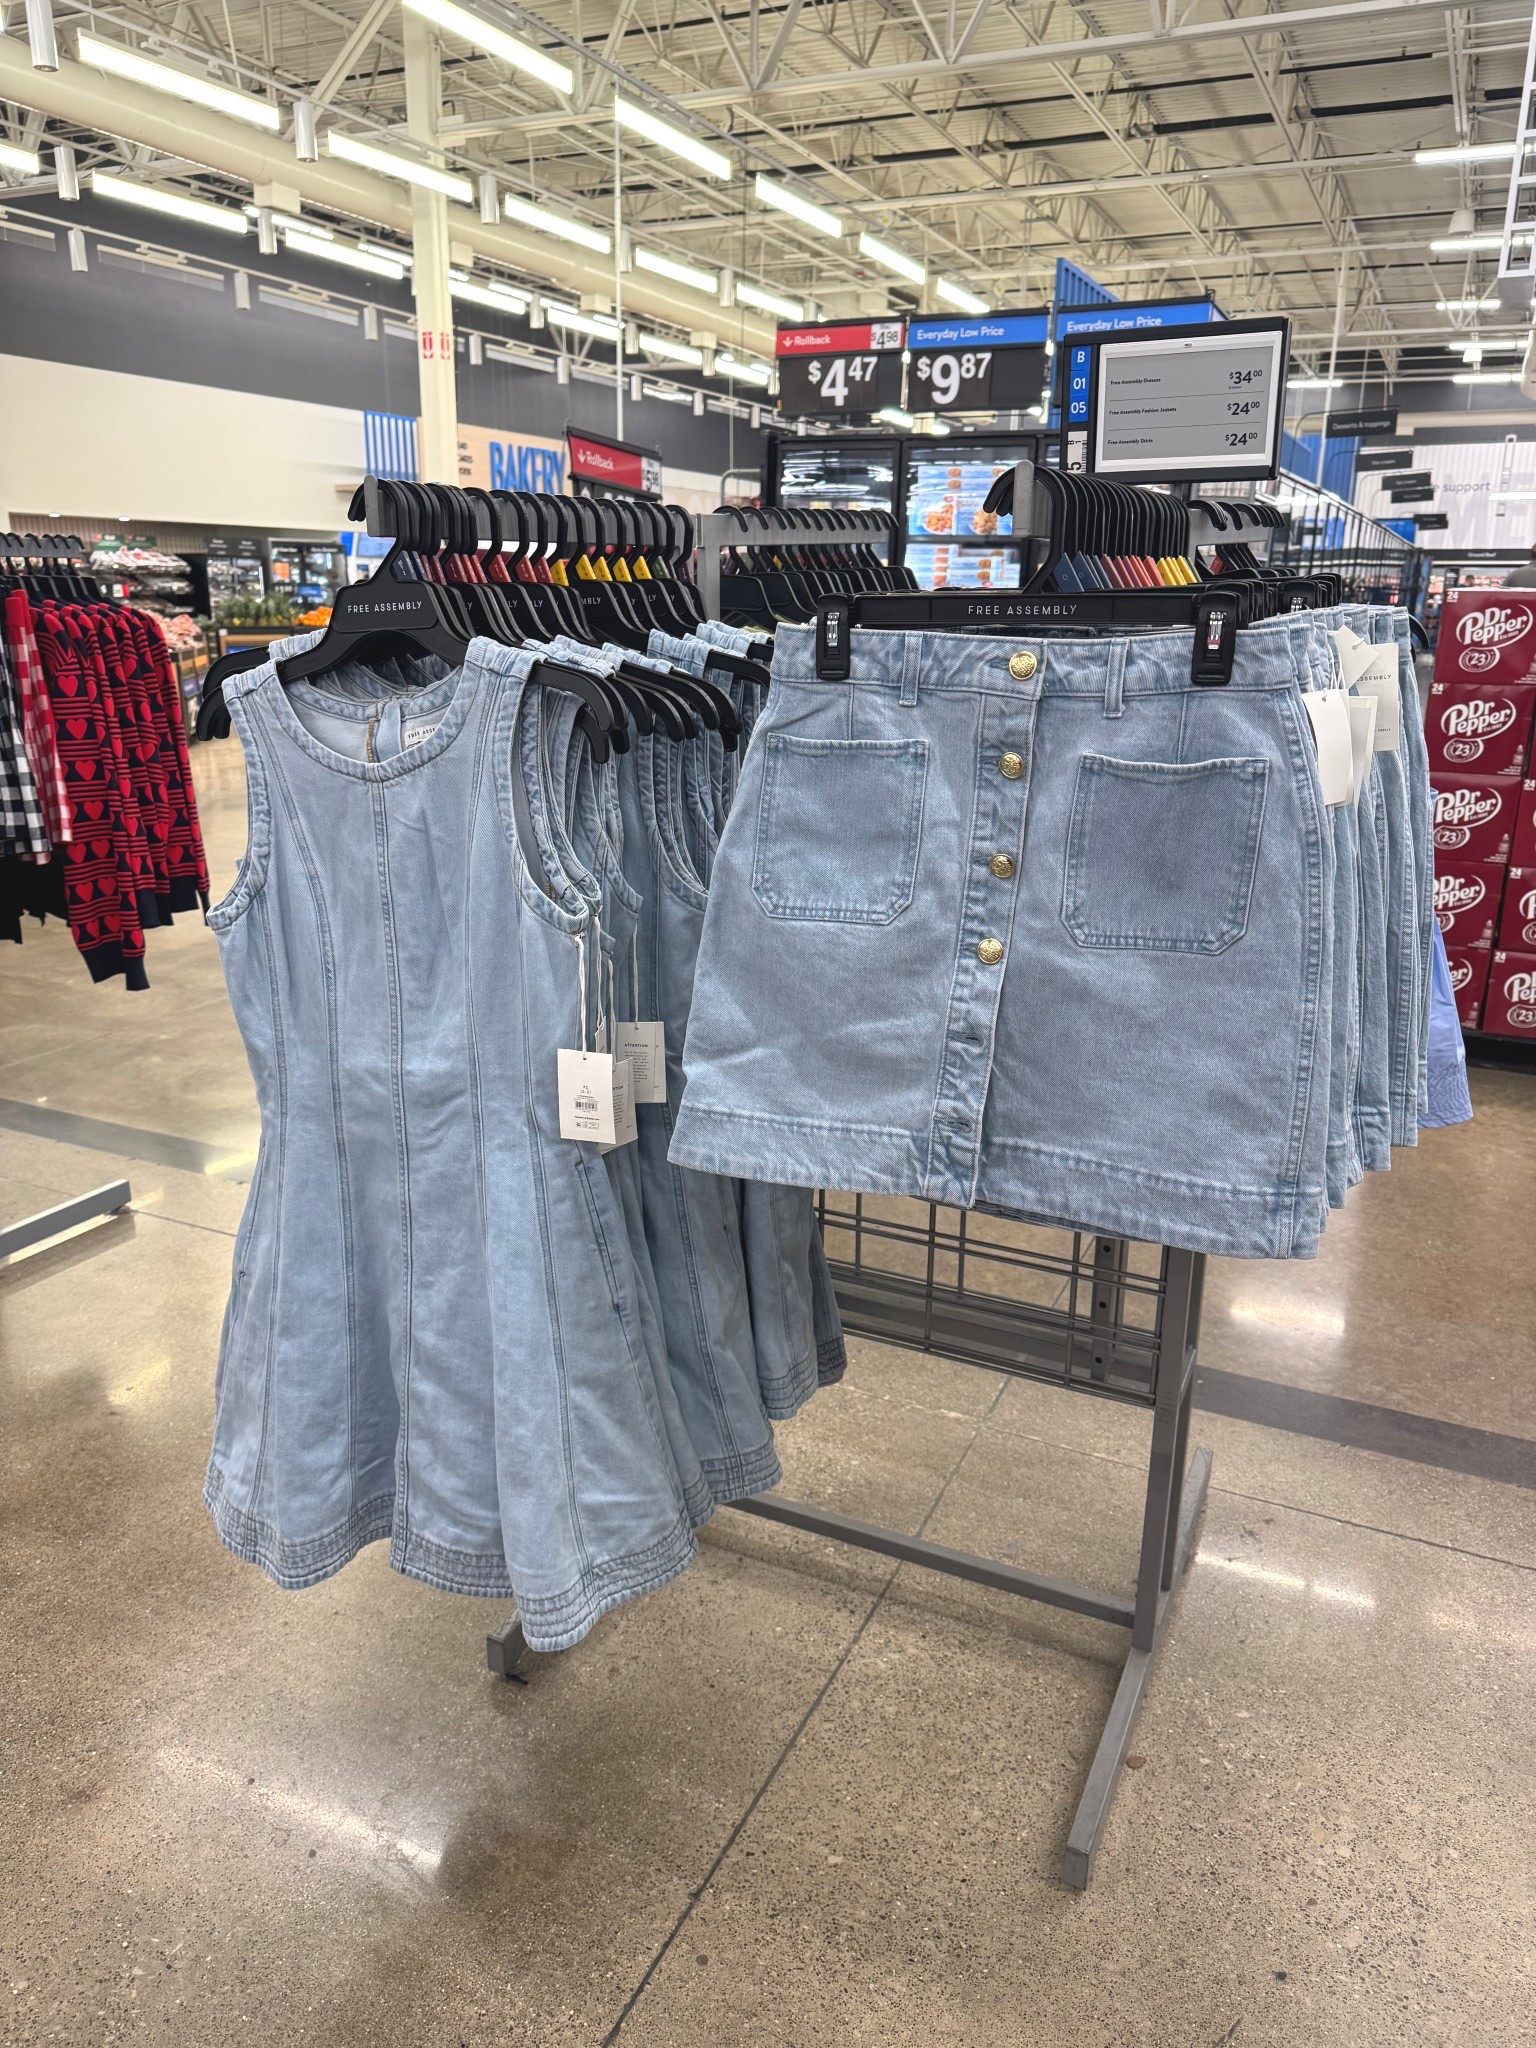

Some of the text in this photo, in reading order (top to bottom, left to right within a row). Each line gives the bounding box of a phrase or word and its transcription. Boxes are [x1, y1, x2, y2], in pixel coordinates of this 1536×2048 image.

[1066, 316, 1162, 333] Everyday Low Price
[794, 334, 831, 346] Rollback
[916, 326, 1005, 342] Everyday Low Price
[1076, 351, 1085, 363] B
[1072, 377, 1086, 390] 01
[1070, 401, 1087, 414] 05
[489, 441, 567, 495] BAKERY
[1442, 482, 1491, 495] support
[1447, 592, 1459, 600] 24
[347, 600, 422, 614] FREE ASSEMBLY
[967, 604, 1077, 616] FREE ASSEMBLY
[1484, 607, 1512, 627] Dr
[1456, 611, 1528, 645] Pepper
[1470, 652, 1487, 666] 23
[1432, 683, 1443, 692] 24
[1468, 700, 1495, 720] Dr
[1441, 704, 1511, 736] Pepper
[1454, 744, 1470, 757] 23
[1455, 789, 1481, 808] Dr
[1435, 792, 1496, 824] Pepper
[1441, 831, 1457, 844] 23
[1510, 868, 1522, 876] 24
[1440, 876, 1465, 893] Dr
[1518, 1009, 1533, 1022] 23
